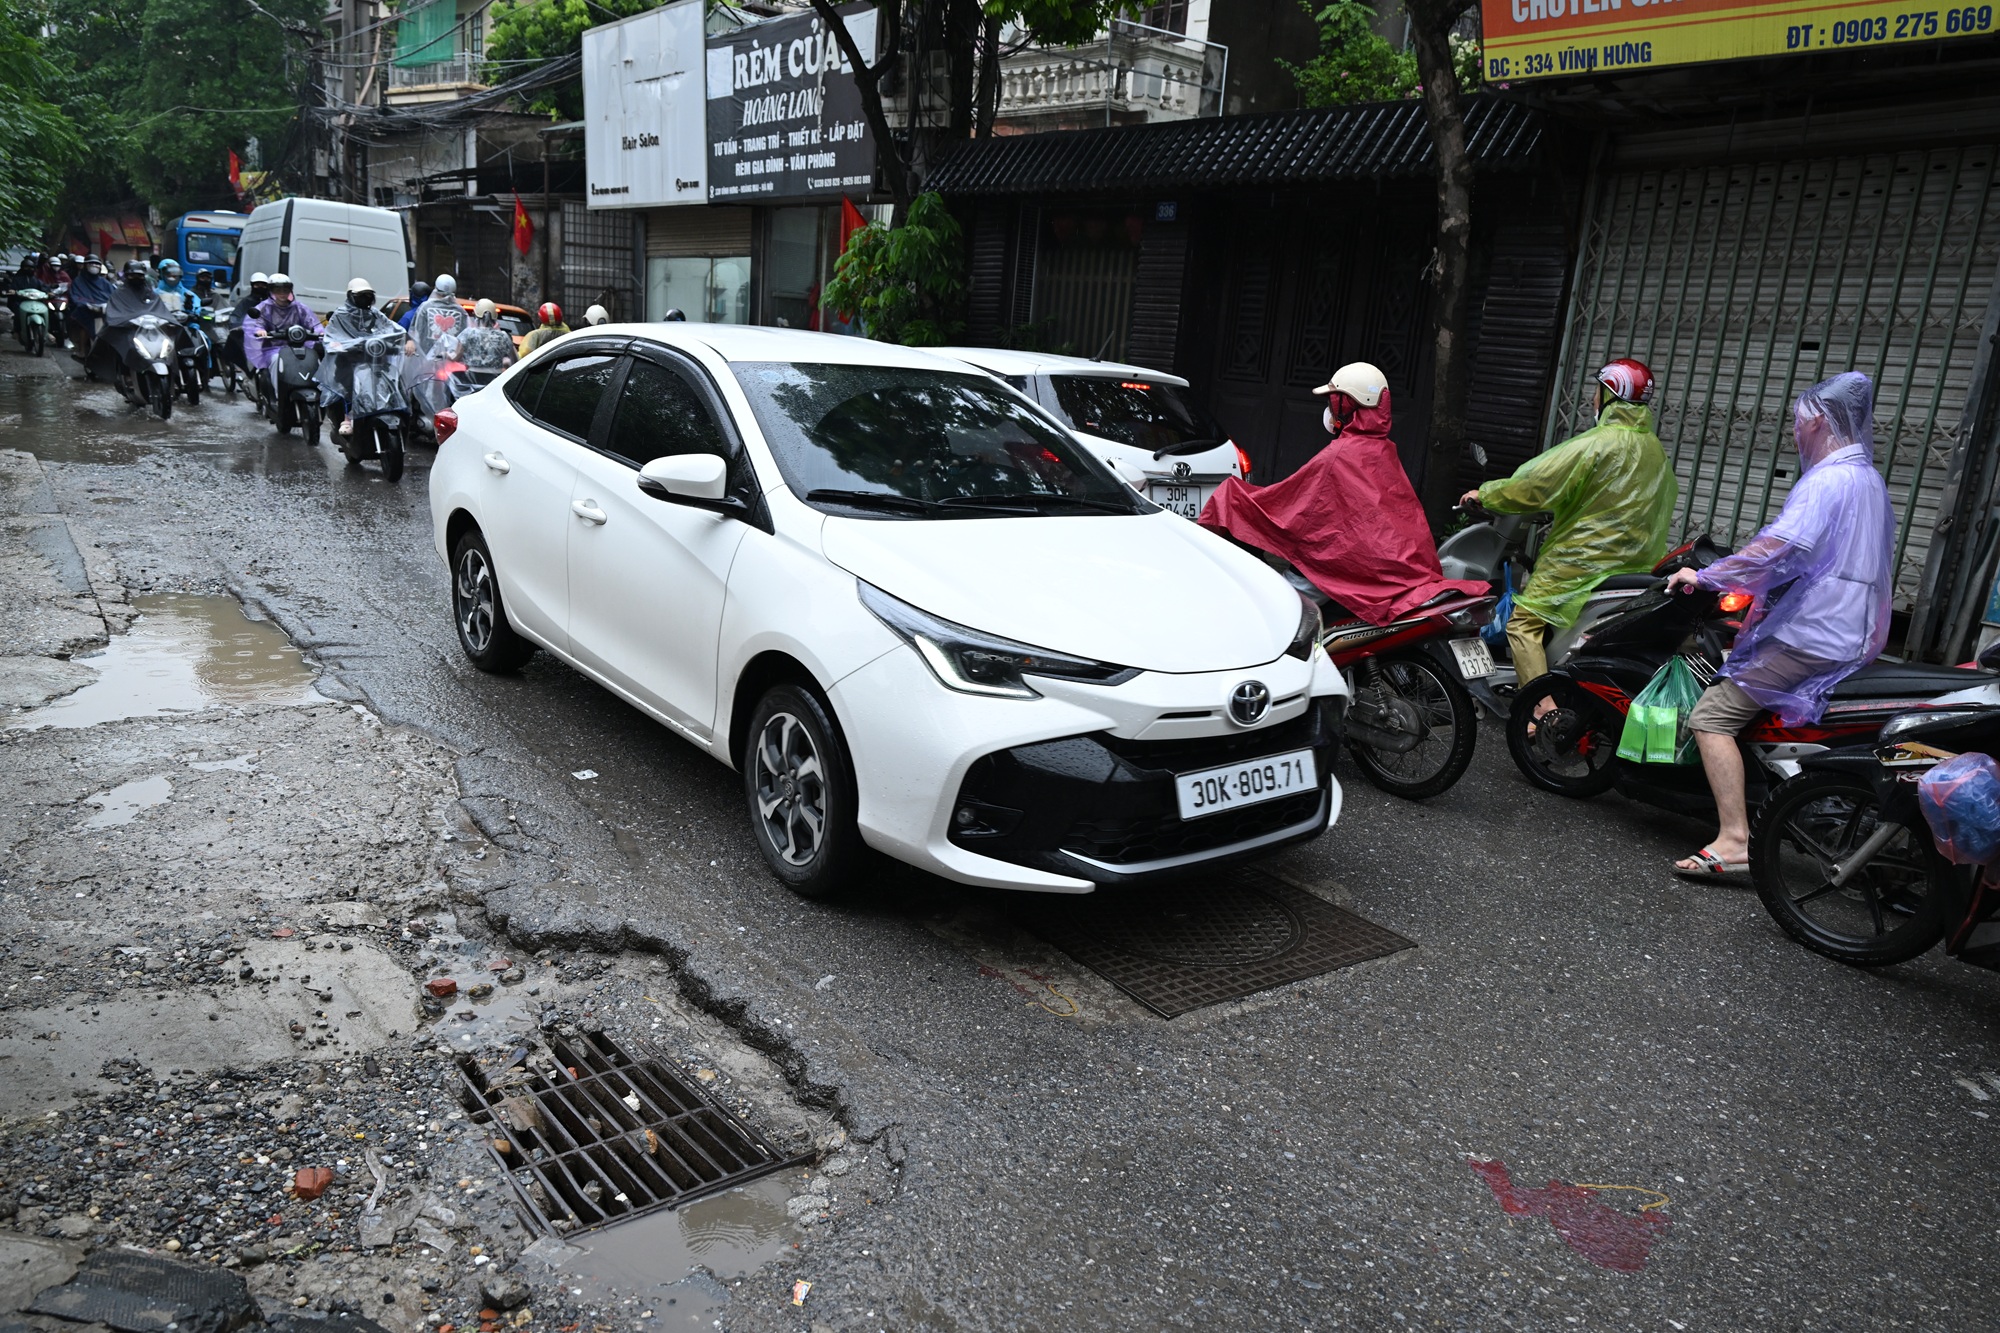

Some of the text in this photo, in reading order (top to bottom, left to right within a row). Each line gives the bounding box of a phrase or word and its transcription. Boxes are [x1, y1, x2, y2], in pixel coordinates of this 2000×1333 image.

[1786, 24, 1813, 49] ĐT
[1832, 16, 1888, 45] 0903
[1894, 11, 1938, 38] 275
[1946, 5, 1992, 34] 669
[734, 18, 841, 89] RÈM CỬA
[1490, 57, 1510, 78] ĐC
[1524, 52, 1553, 75] 334
[1558, 45, 1598, 71] VĨNH
[1604, 42, 1652, 67] HƯNG
[743, 88, 787, 127] HOÀNG
[622, 132, 660, 150] Hair Salon
[714, 141, 724, 157] TƯ
[724, 136, 738, 156] VẤN
[743, 136, 766, 153] TRANG
[768, 131, 780, 149] TRÍ
[788, 126, 810, 147] THIẾT
[829, 120, 846, 142] LẮP
[847, 120, 865, 142] ĐẶT
[735, 160, 751, 176] RÈM
[752, 160, 764, 174] GIA
[766, 156, 784, 173] ĐÌNH
[790, 153, 806, 171] VĂN
[808, 150, 836, 169] PHÒNG
[1158, 205, 1174, 218] 336
[1166, 488, 1188, 502] 30H
[1192, 758, 1304, 809] 30K-809.71
